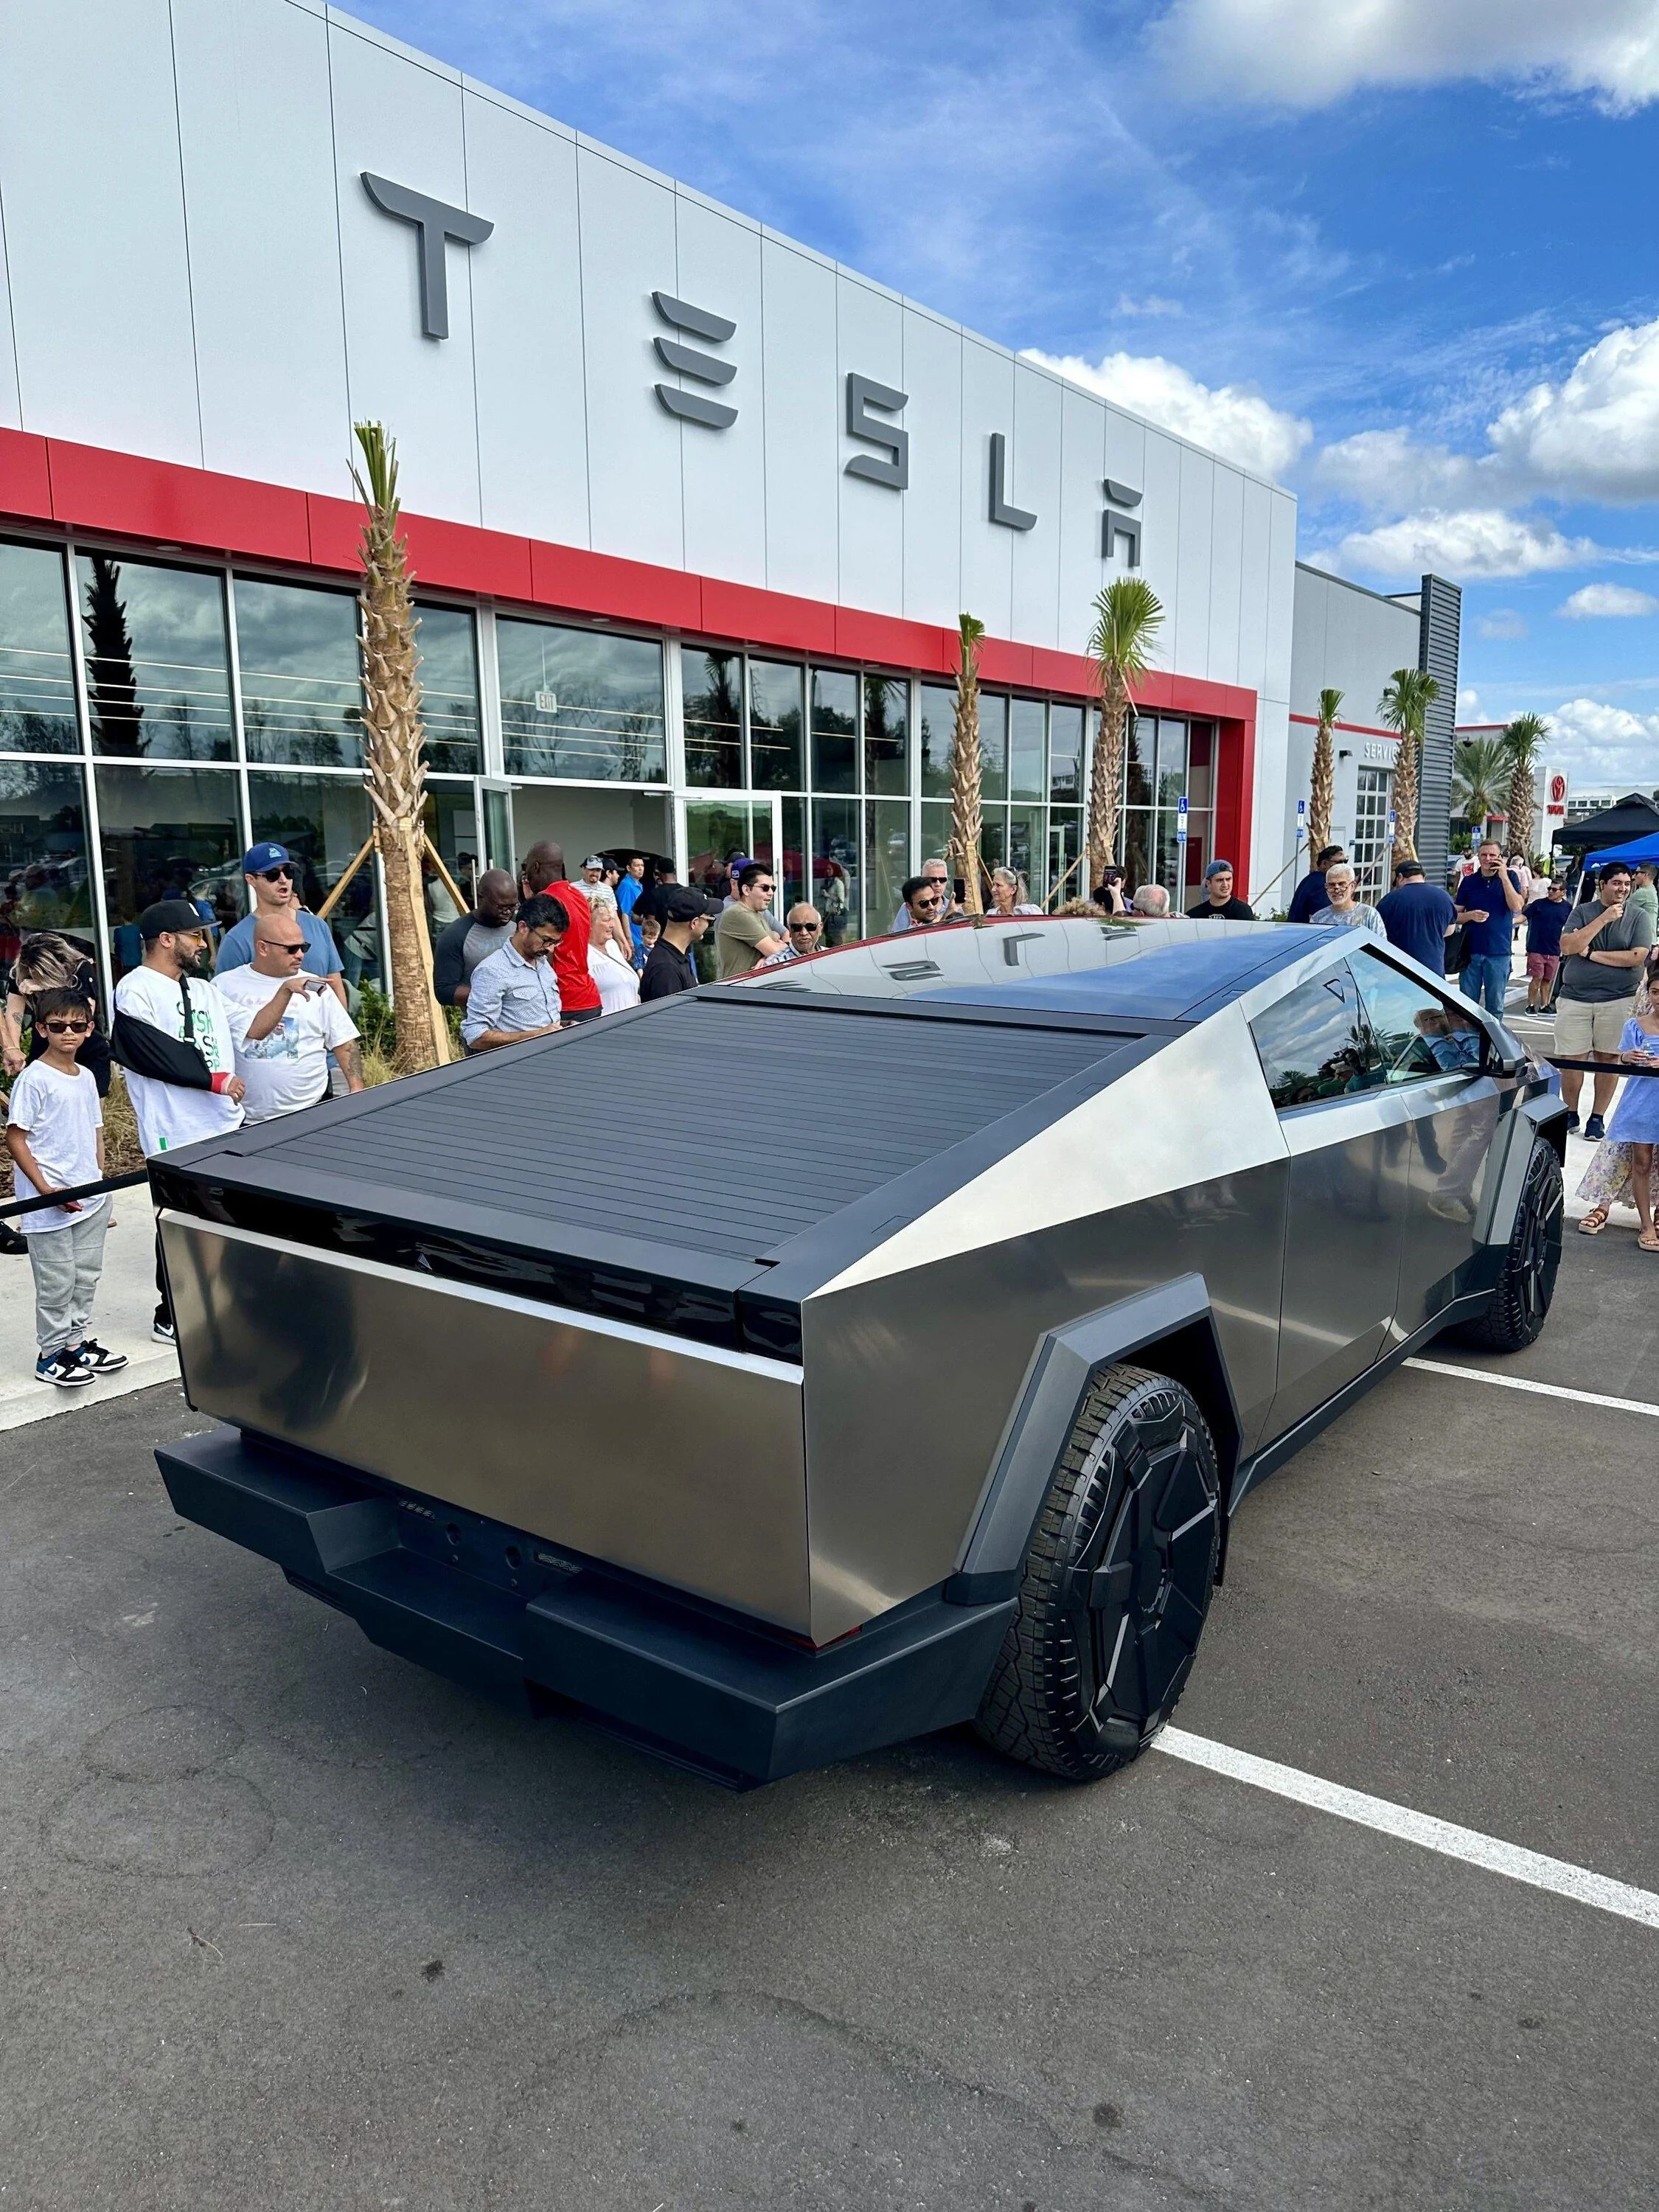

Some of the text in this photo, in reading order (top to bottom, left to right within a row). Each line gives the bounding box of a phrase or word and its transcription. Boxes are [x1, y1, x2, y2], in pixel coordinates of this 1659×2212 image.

[361, 172, 1144, 567] TESLA
[540, 693, 554, 710] EXIT
[1364, 742, 1398, 765] SERVIC
